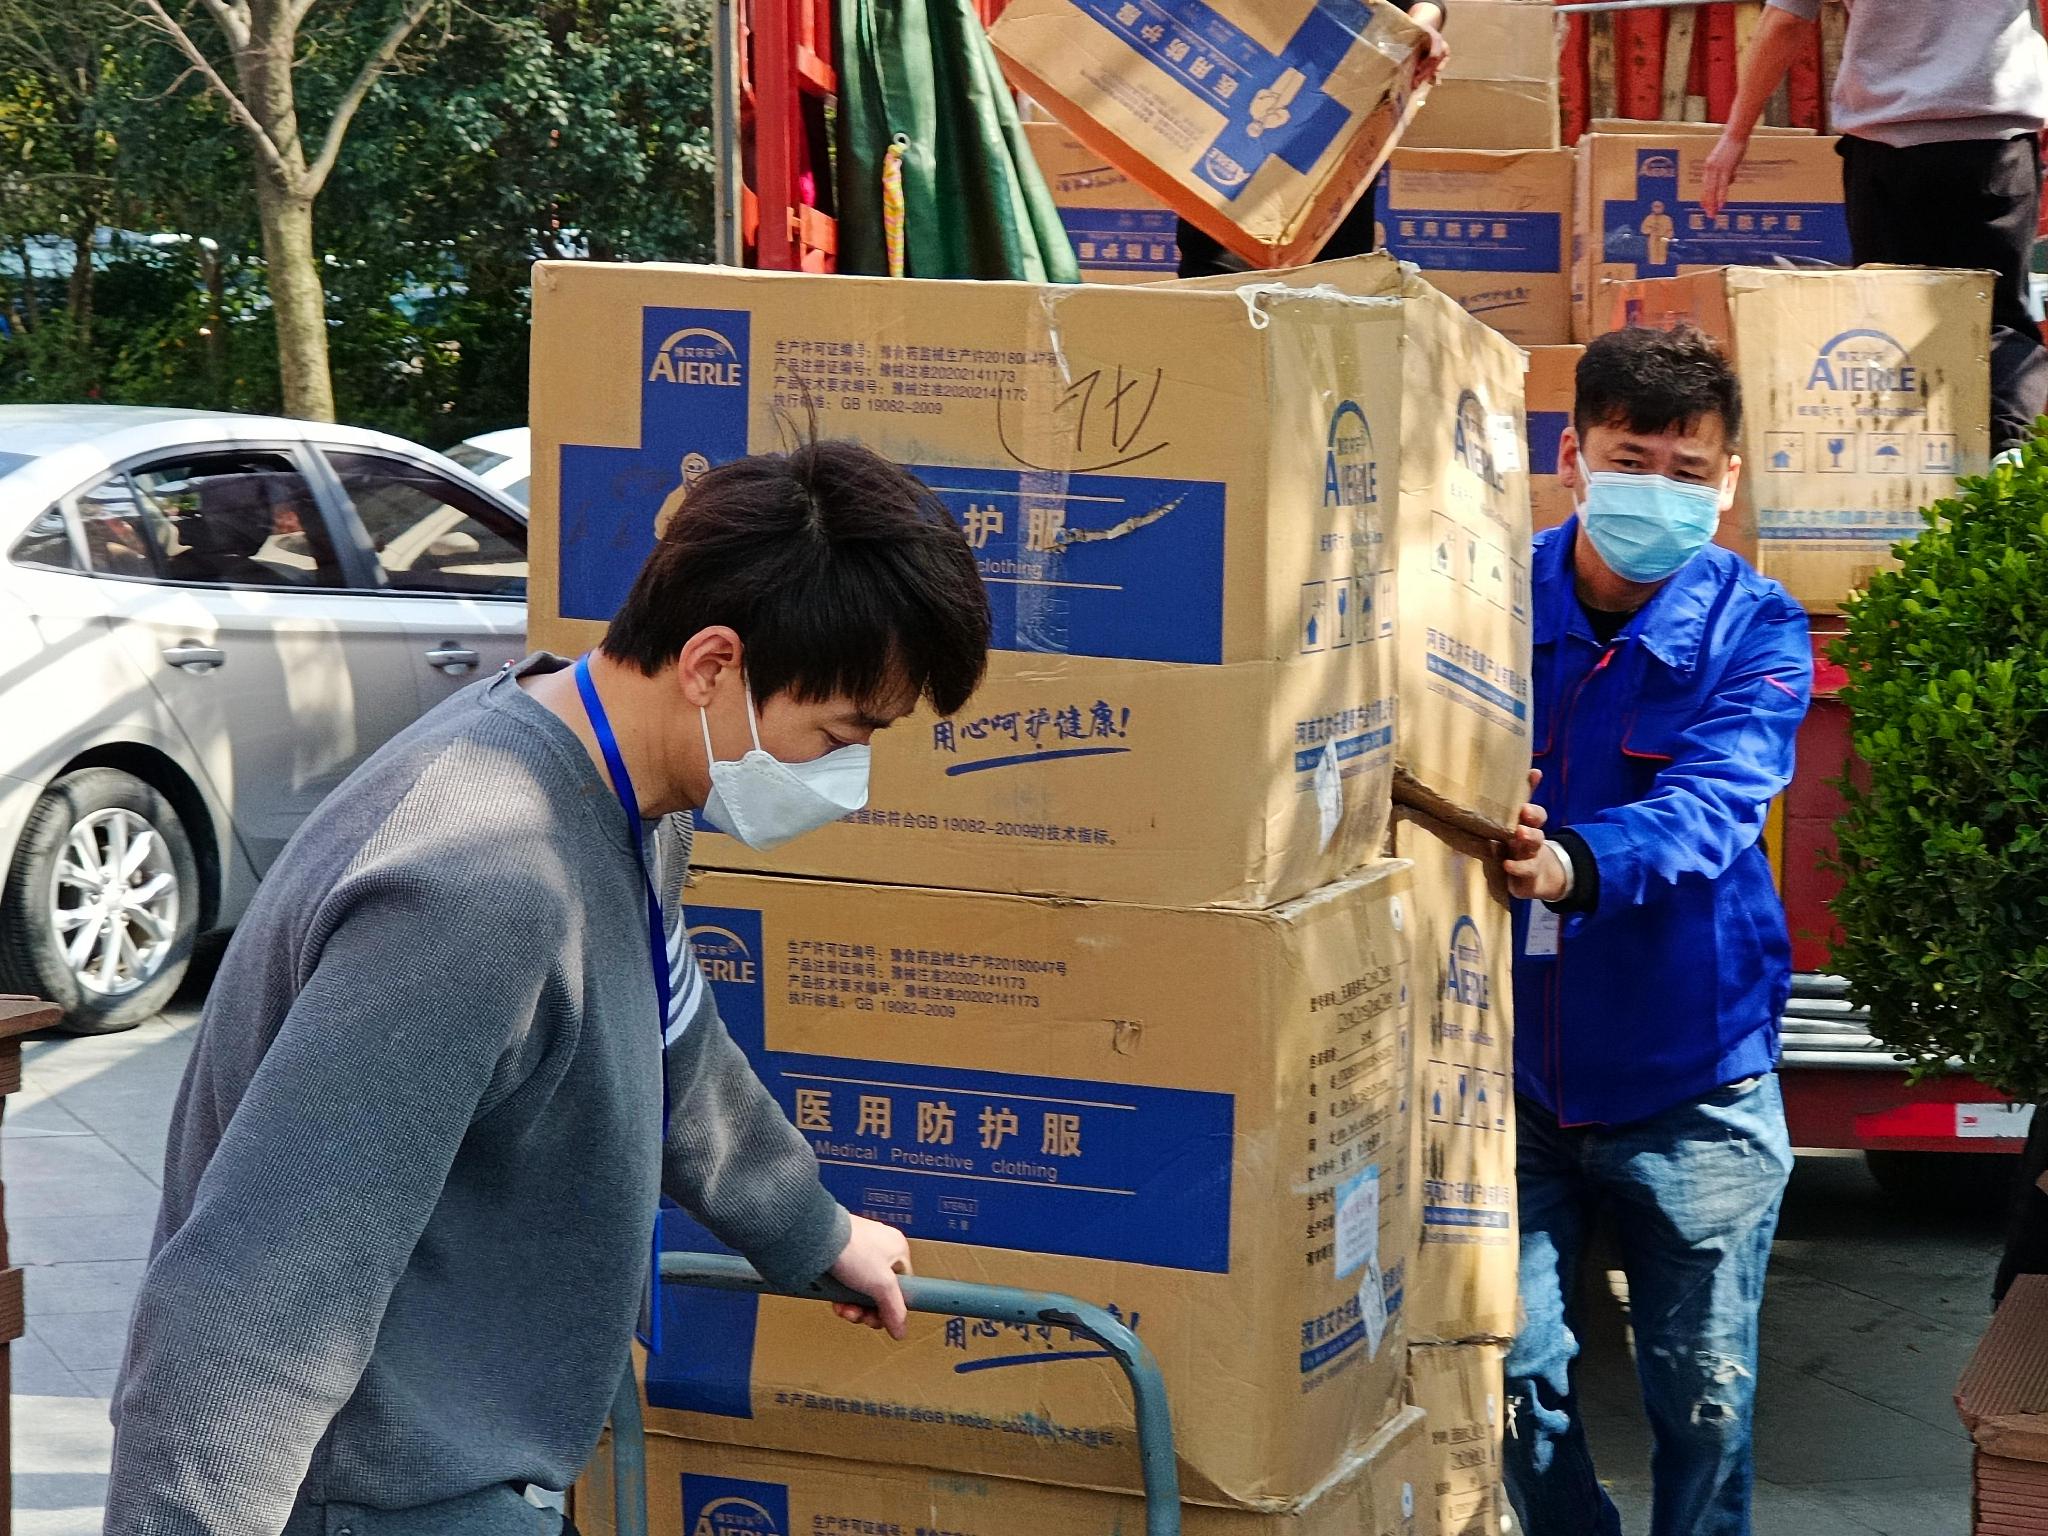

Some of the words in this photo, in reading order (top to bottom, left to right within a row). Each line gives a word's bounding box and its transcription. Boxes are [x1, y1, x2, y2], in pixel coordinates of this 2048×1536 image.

[648, 352, 742, 386] AIERLE
[699, 959, 755, 983] ERLE
[795, 1088, 1082, 1158] 医用防护服
[815, 1139, 878, 1160] Medical
[891, 1147, 974, 1171] Protective
[991, 1159, 1058, 1183] clothing
